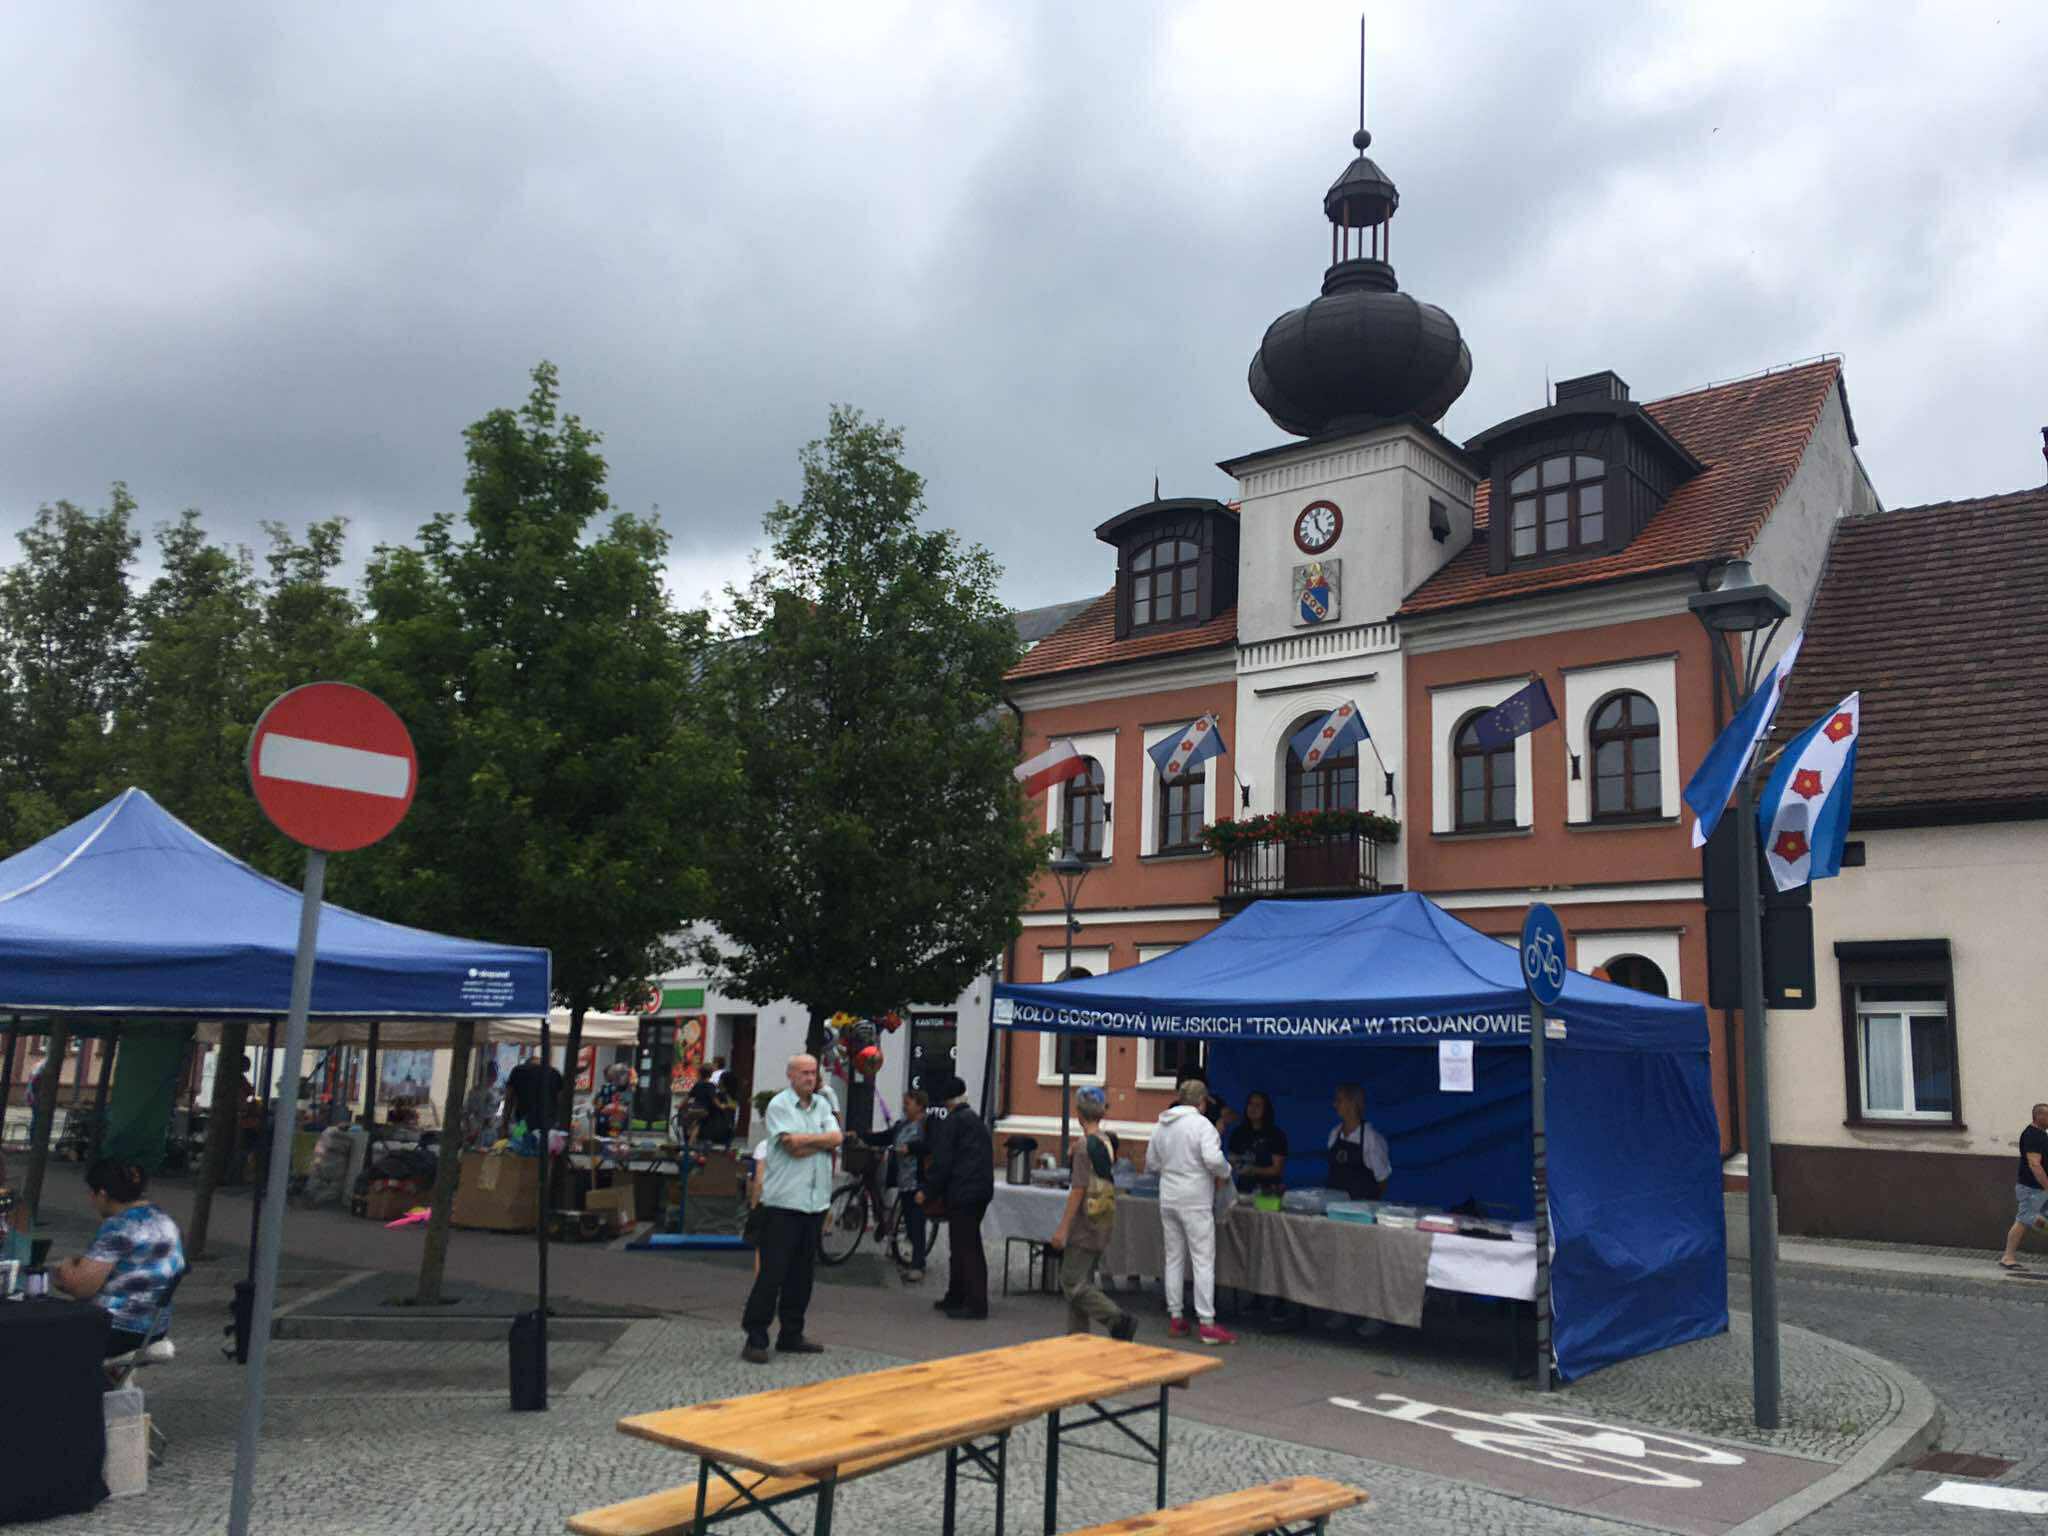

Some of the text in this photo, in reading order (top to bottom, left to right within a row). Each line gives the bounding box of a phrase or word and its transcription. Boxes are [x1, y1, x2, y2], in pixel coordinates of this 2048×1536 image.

[1013, 1006, 1531, 1035] KOŁO GOSPODYŃ WIEJSKICH "TROJANKA" W TROJANOWIE
